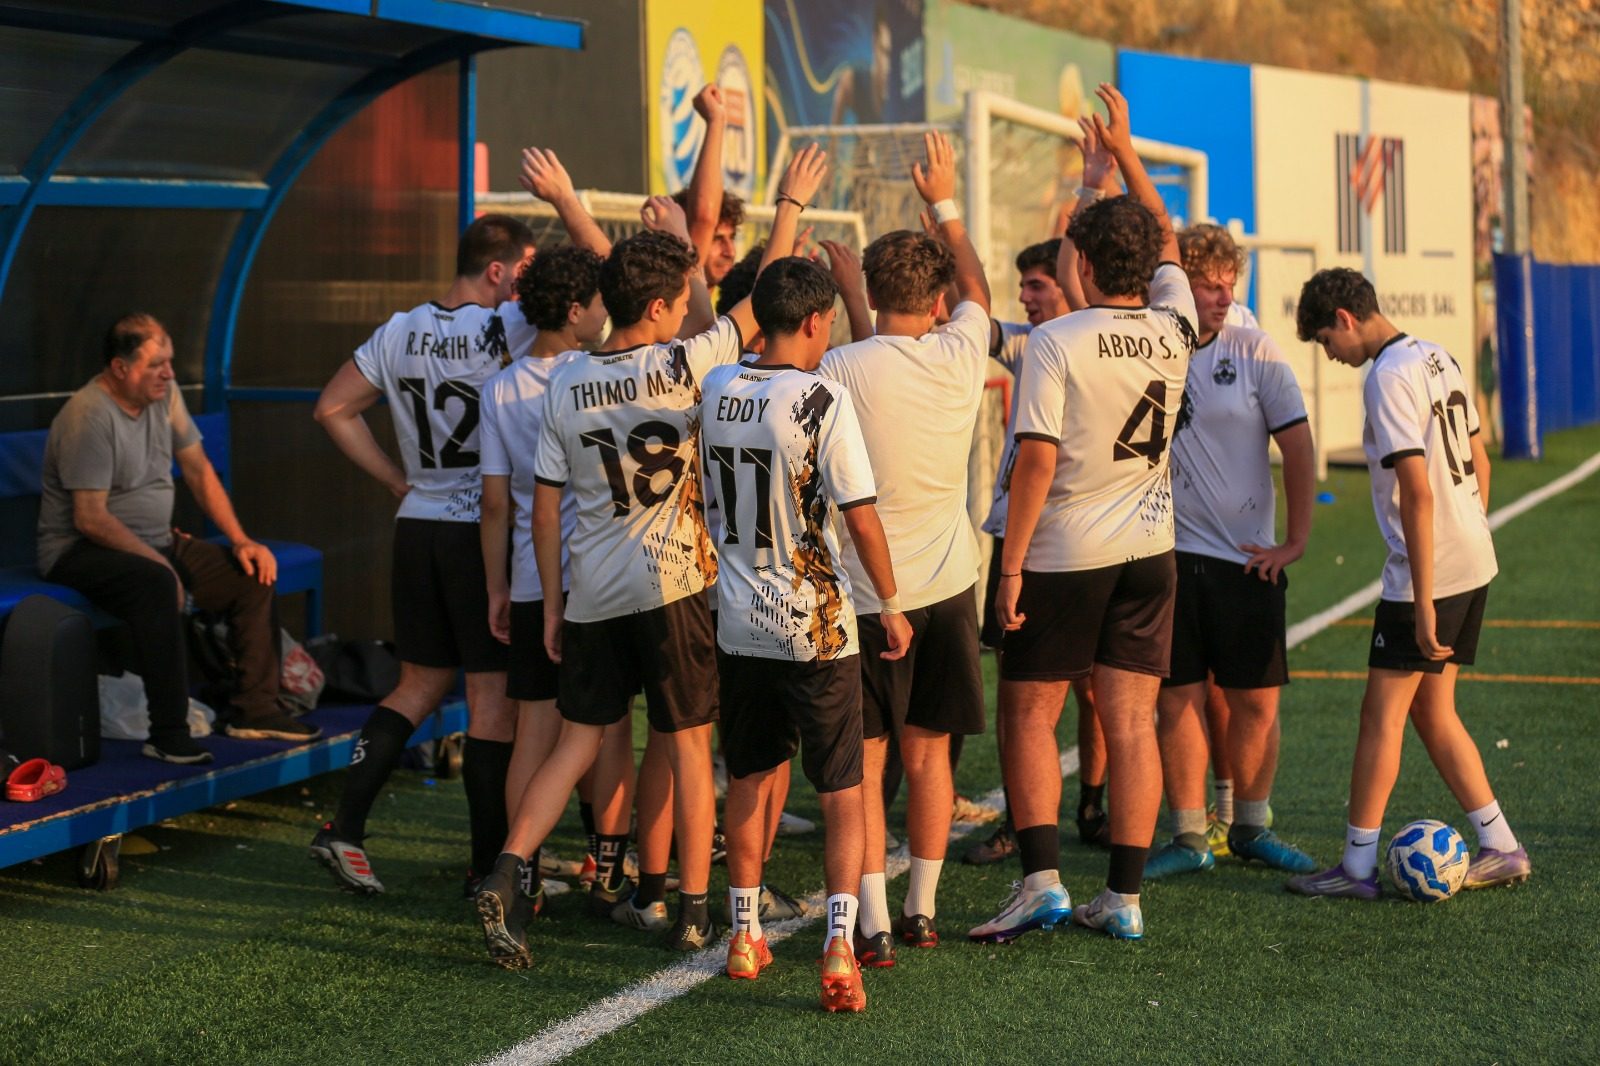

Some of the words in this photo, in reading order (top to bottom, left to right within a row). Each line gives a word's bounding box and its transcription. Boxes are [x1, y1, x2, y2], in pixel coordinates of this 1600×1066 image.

[570, 377, 637, 411] THIMO
[646, 370, 673, 397] M.
[1098, 333, 1152, 360] ABDO
[1159, 335, 1177, 360] S.
[398, 377, 480, 469] 12
[716, 396, 771, 424] EDDY
[1113, 380, 1168, 470] 4
[1431, 390, 1475, 487] 10
[579, 421, 686, 519] 18
[709, 445, 774, 549] 11
